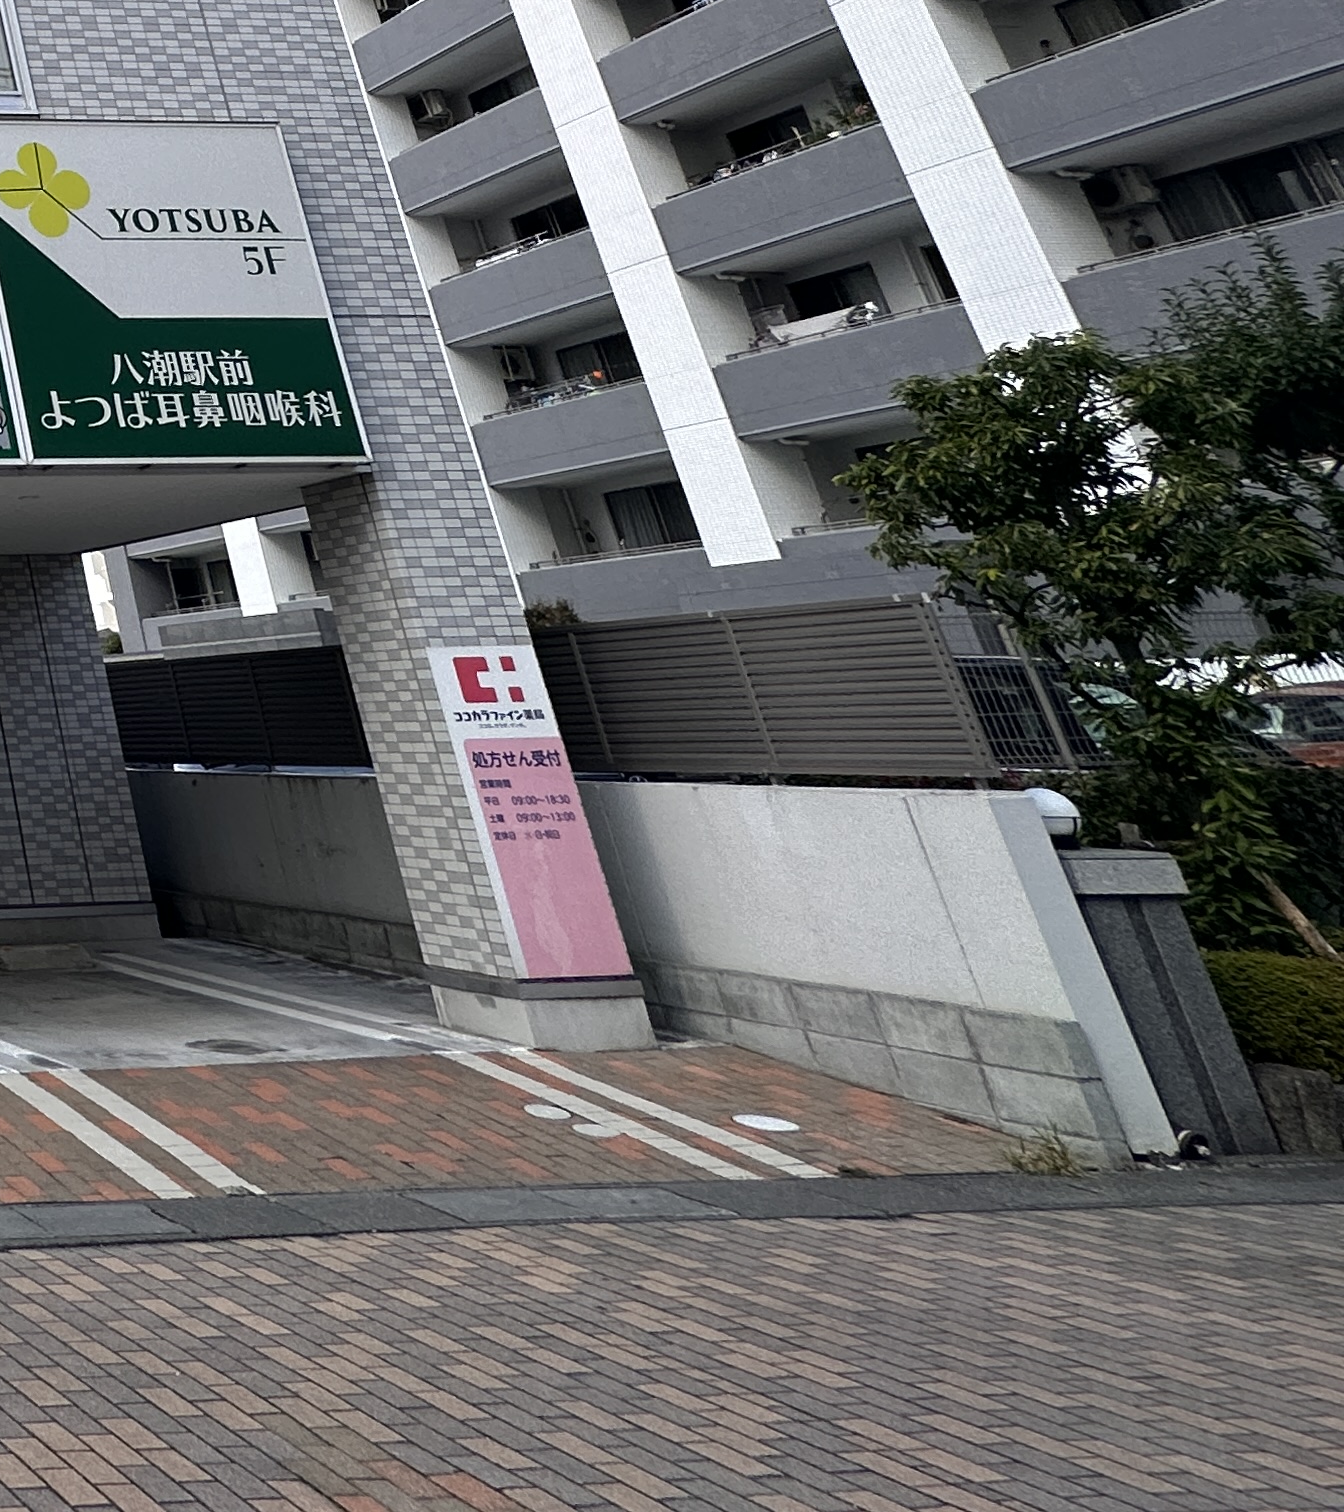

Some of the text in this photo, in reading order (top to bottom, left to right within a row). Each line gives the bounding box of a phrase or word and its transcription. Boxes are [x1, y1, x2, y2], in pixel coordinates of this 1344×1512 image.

[108, 208, 281, 234] YOTSUBA
[243, 245, 288, 276] 5F
[111, 349, 254, 388] 八潮駅前
[40, 390, 344, 430] よつば耳鼻咽喉科
[472, 749, 562, 769] 処方せん受付
